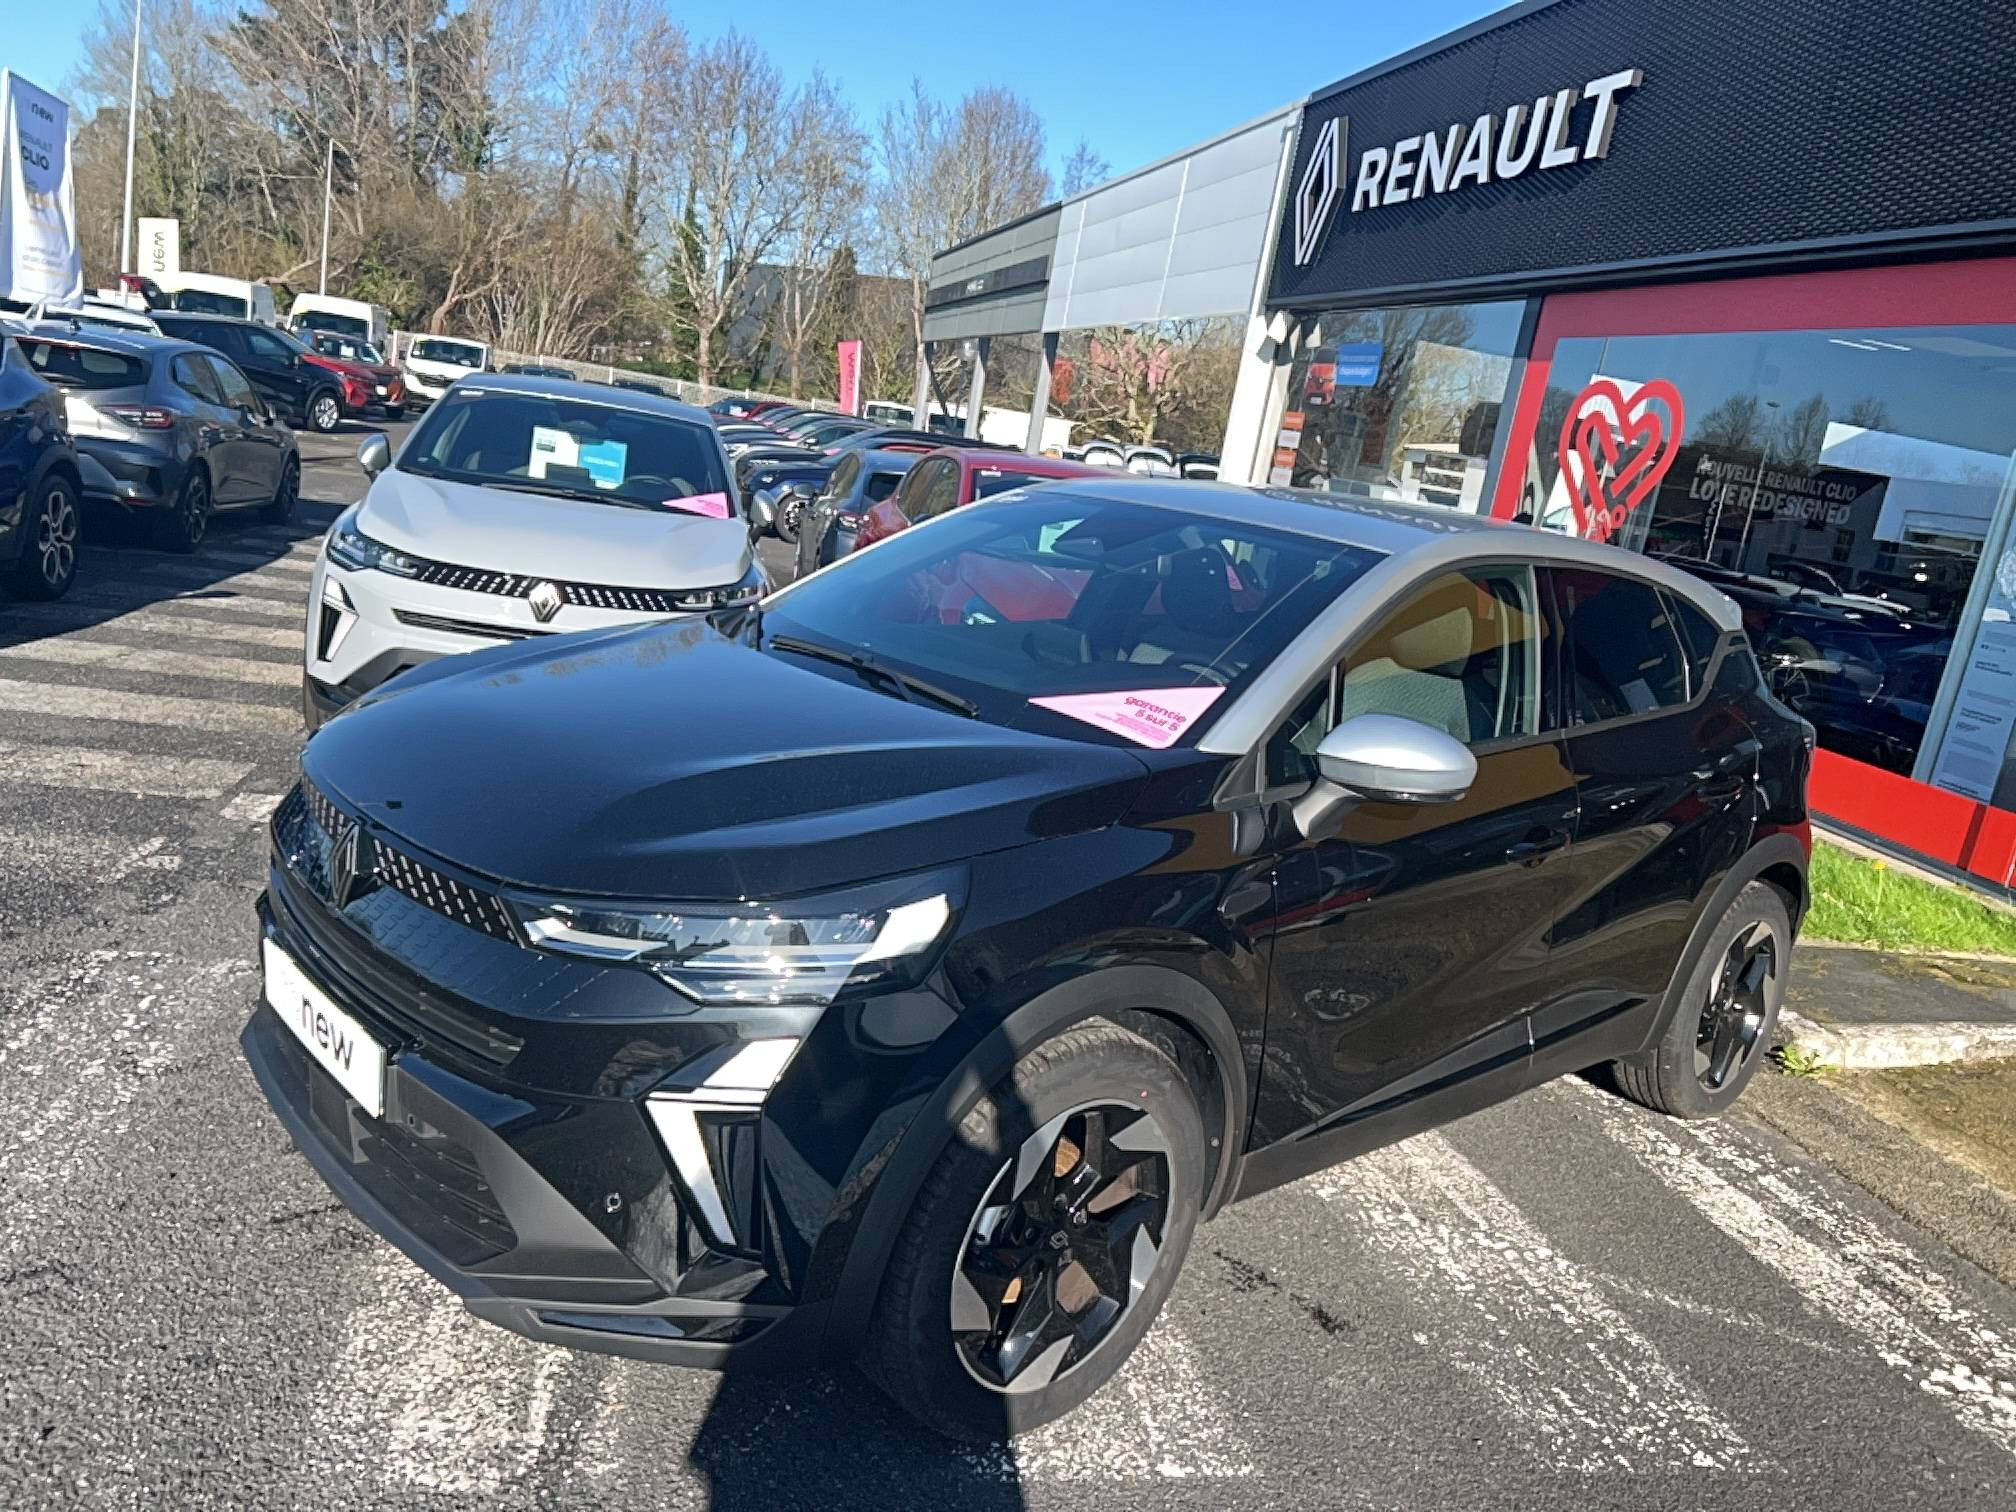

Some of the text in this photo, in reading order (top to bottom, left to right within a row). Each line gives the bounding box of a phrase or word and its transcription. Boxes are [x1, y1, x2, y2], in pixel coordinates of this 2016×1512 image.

[21, 145, 50, 171] CLIO
[1351, 68, 1644, 213] RENAULT
[1689, 477, 1850, 525] LOVE REDESIGNED
[1764, 470, 1826, 496] RENAULT
[1825, 481, 1858, 501] CLIO
[1124, 697, 1186, 723] garantie
[301, 994, 354, 1071] new
